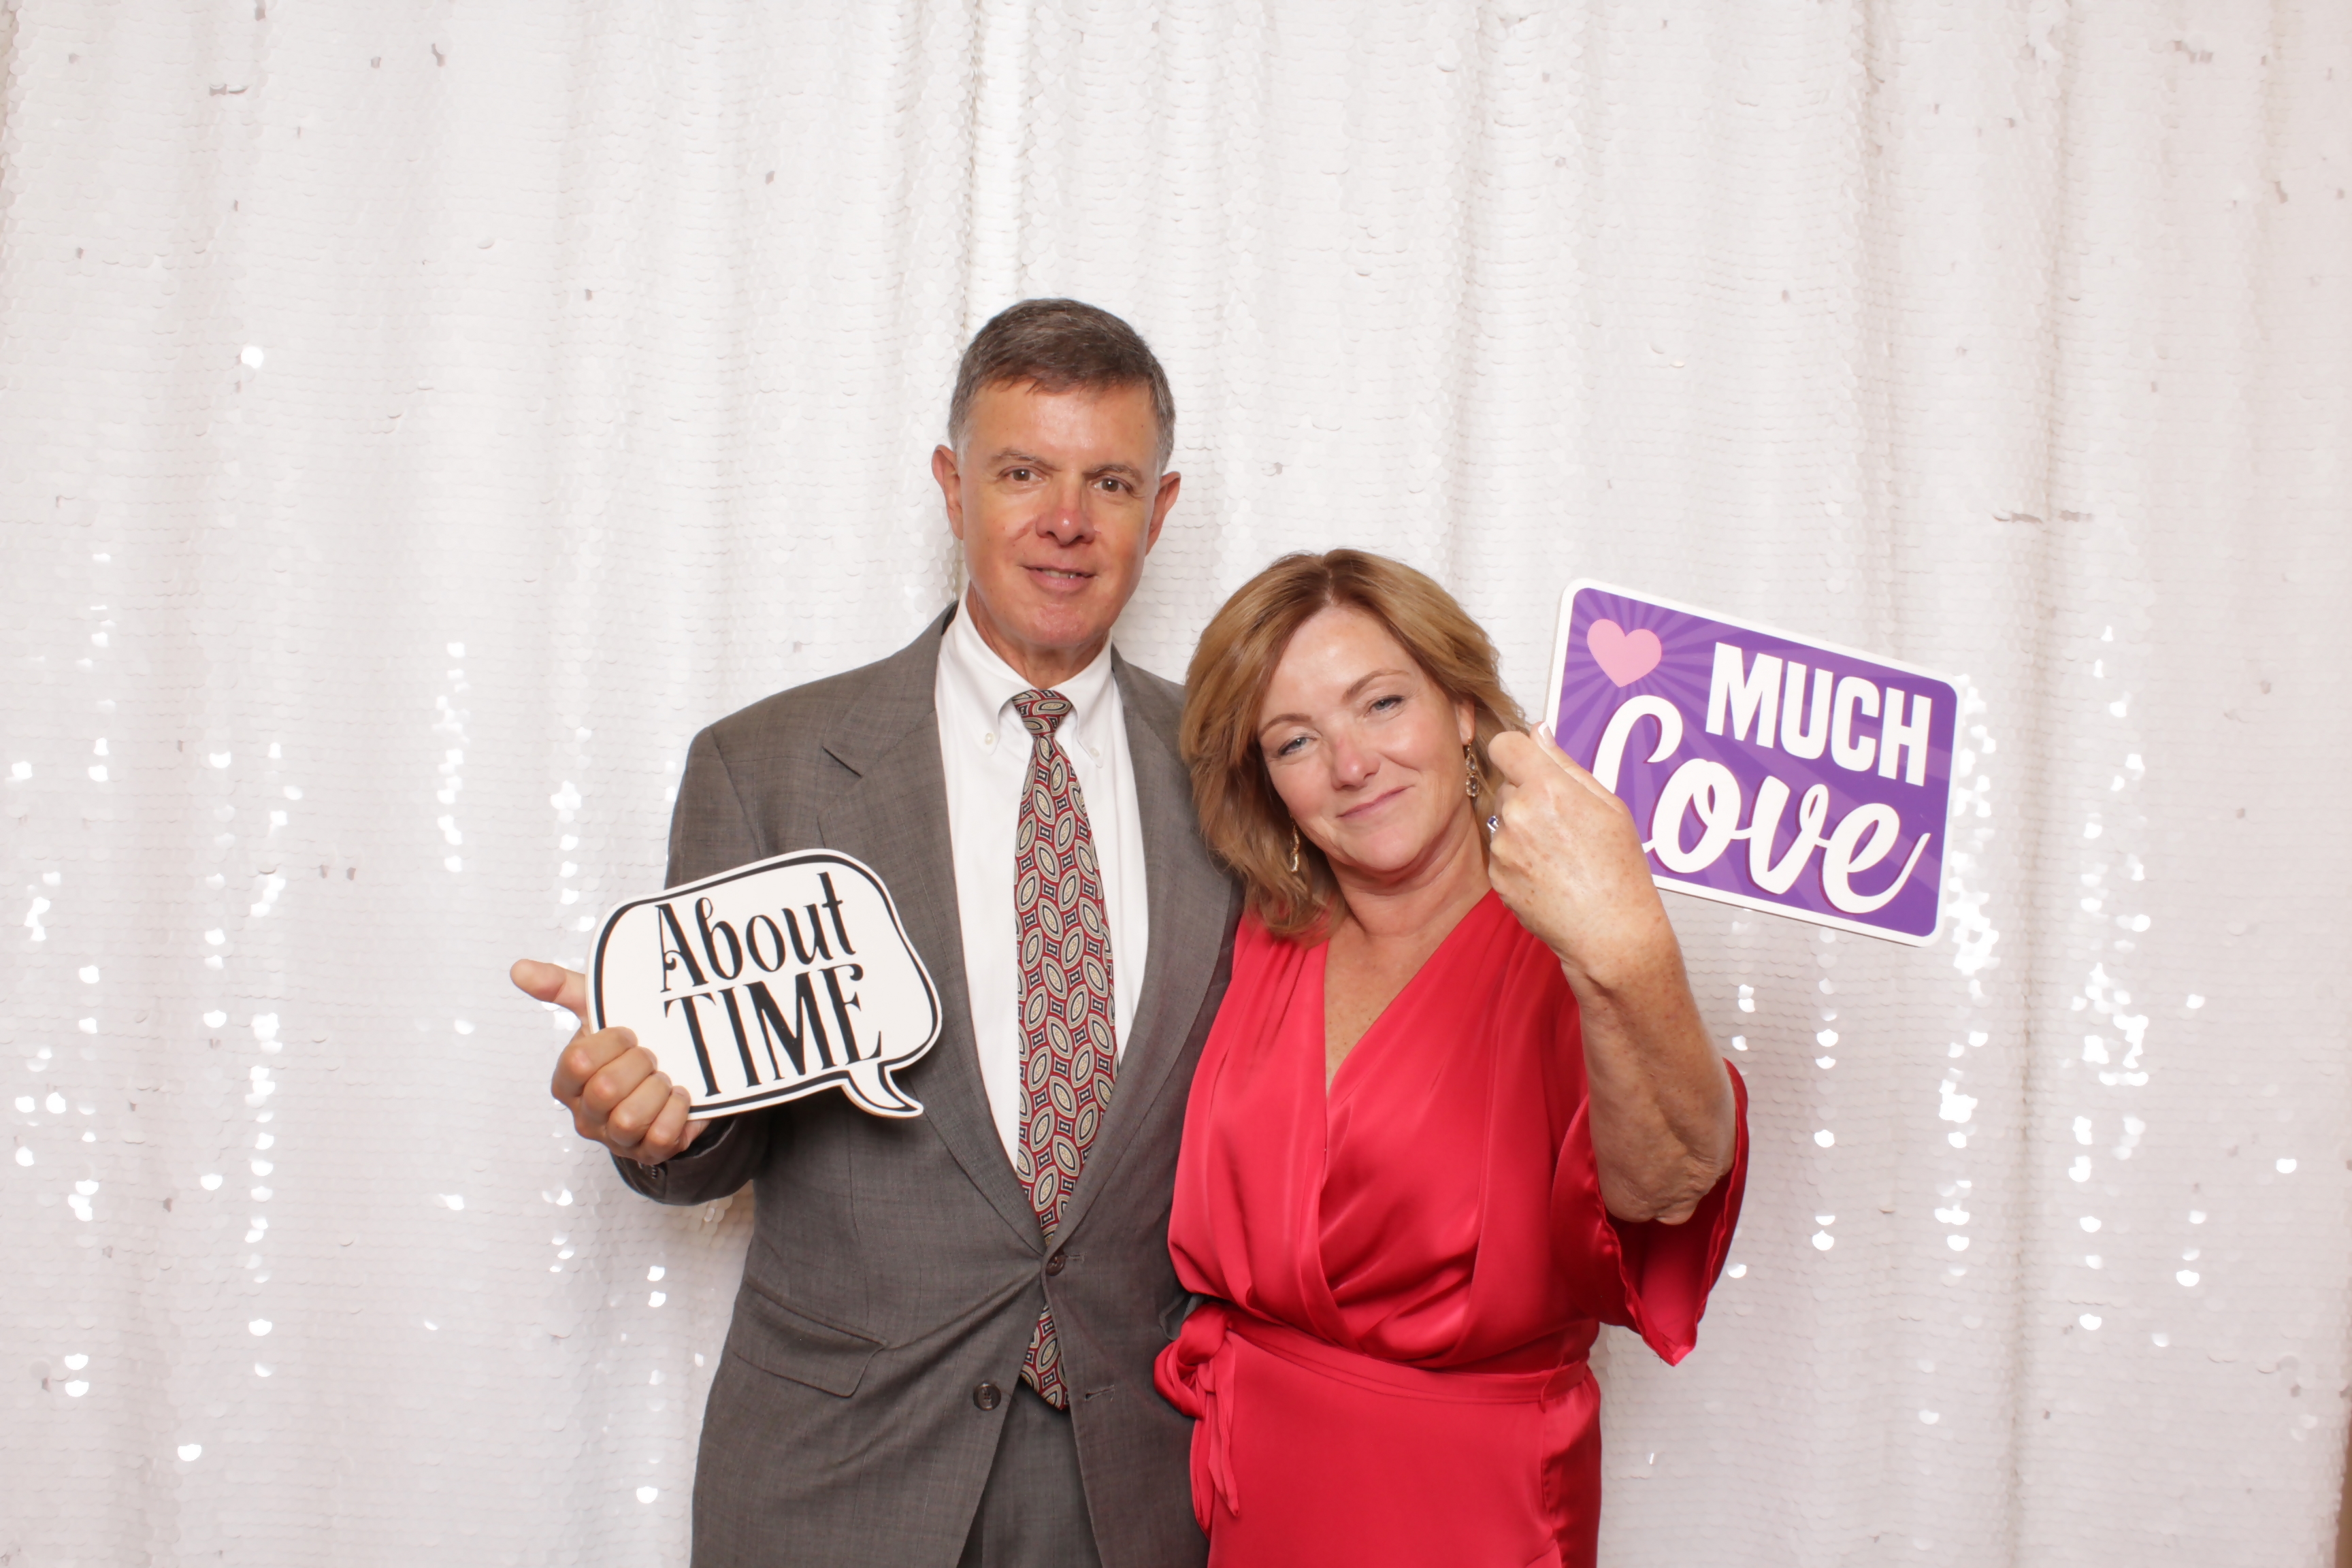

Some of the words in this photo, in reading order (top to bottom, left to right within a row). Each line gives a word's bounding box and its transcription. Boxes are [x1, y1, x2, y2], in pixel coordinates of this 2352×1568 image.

[1705, 642, 1931, 787] MUCH
[655, 872, 856, 992] About
[664, 964, 881, 1096] TIME
